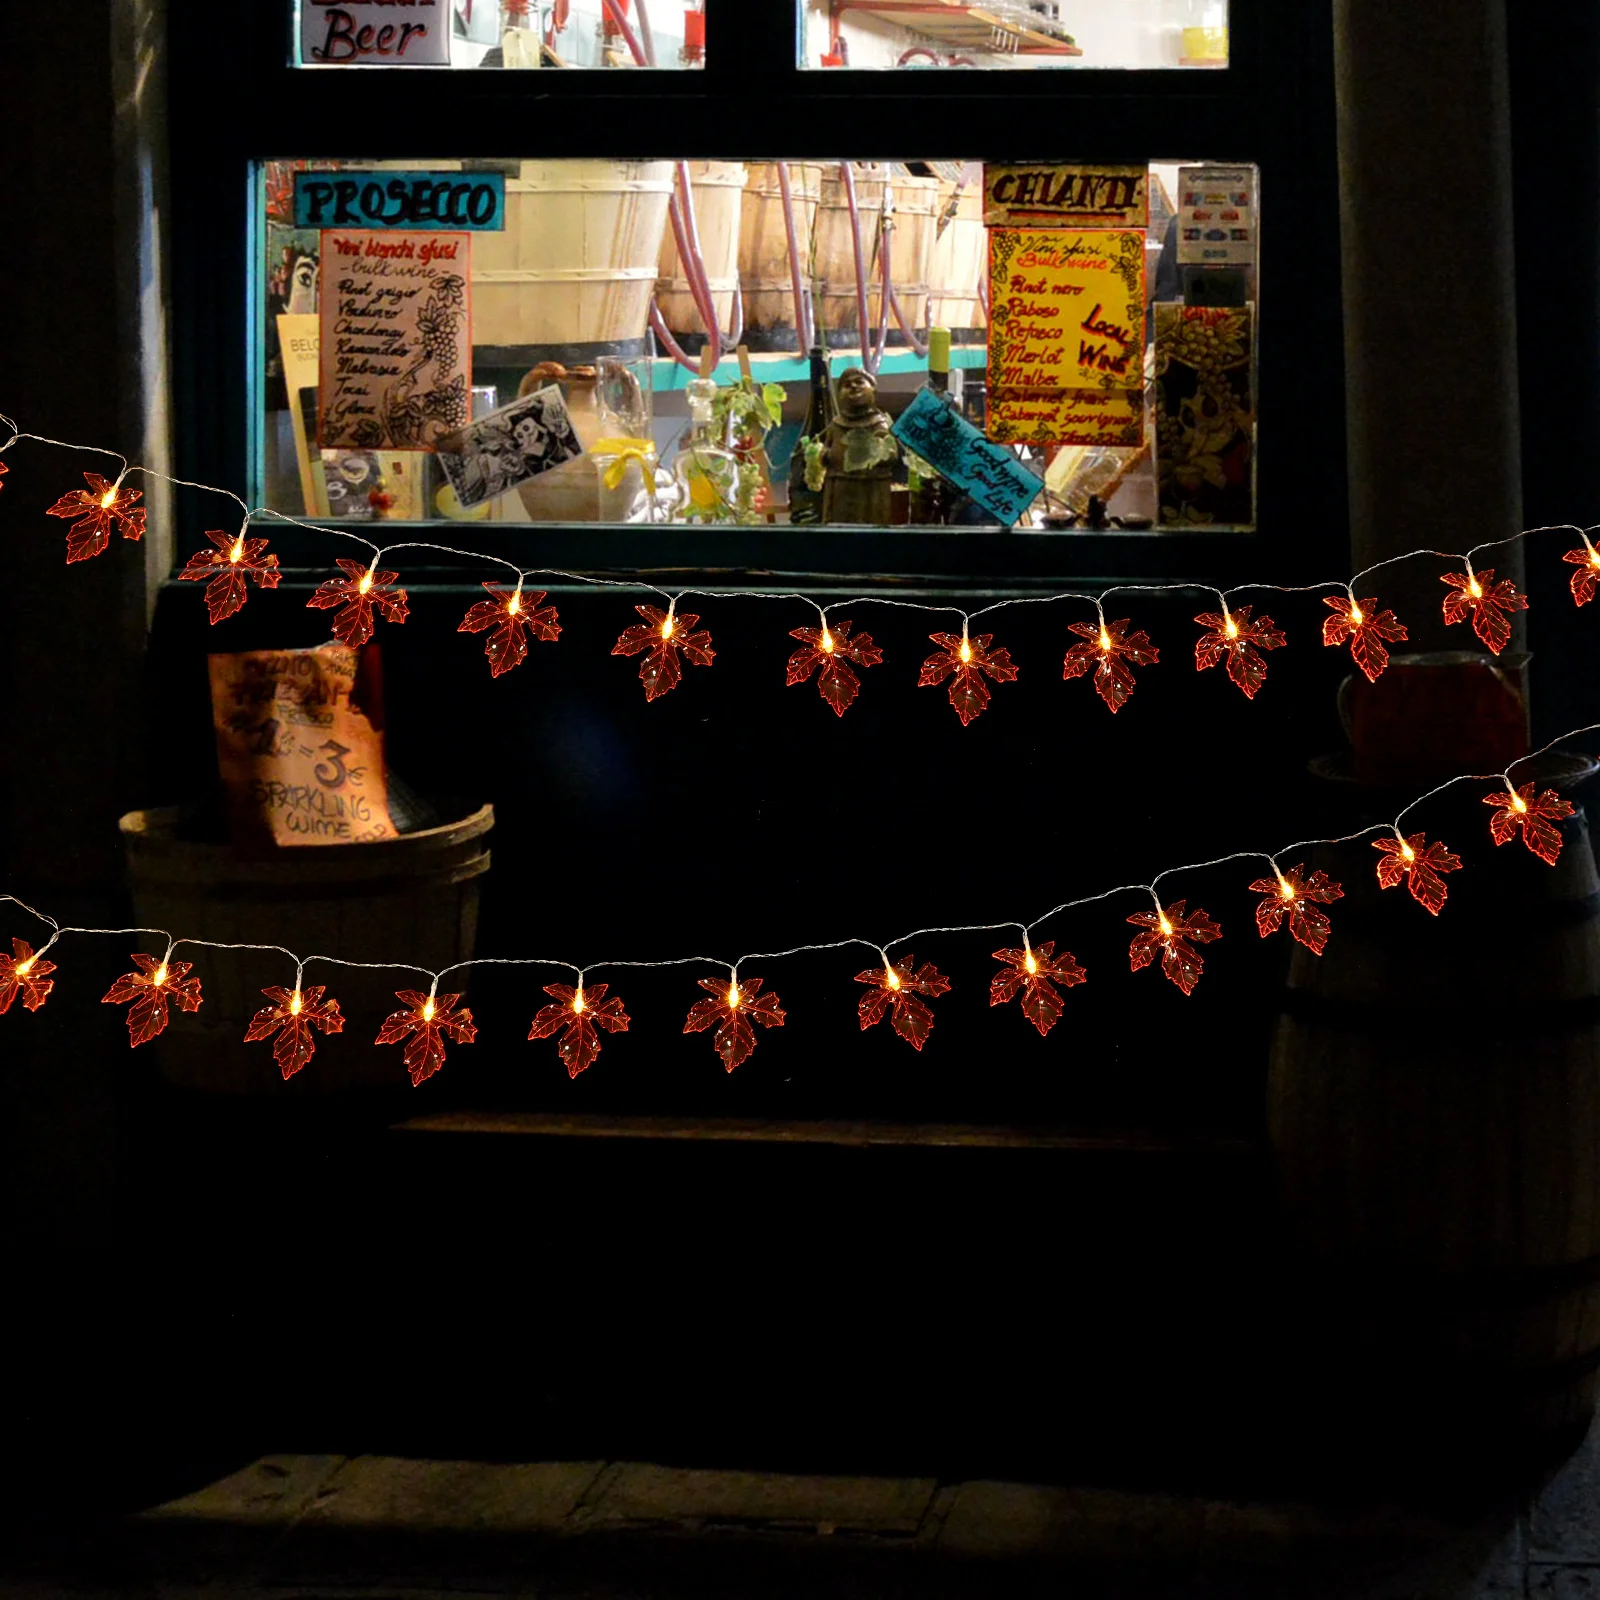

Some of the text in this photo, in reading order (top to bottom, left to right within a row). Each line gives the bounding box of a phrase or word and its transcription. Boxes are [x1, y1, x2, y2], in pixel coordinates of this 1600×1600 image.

[311, 9, 427, 64] Beer
[992, 171, 1141, 210] CHIANTI
[303, 180, 496, 225] PROSECCO
[1009, 274, 1085, 296] Pinot nero
[1007, 297, 1059, 318] Raboso
[1005, 319, 1063, 343] Refosco
[1002, 344, 1064, 365] Merlot
[1001, 366, 1058, 386] Malbec
[999, 405, 1061, 422] Cabernet
